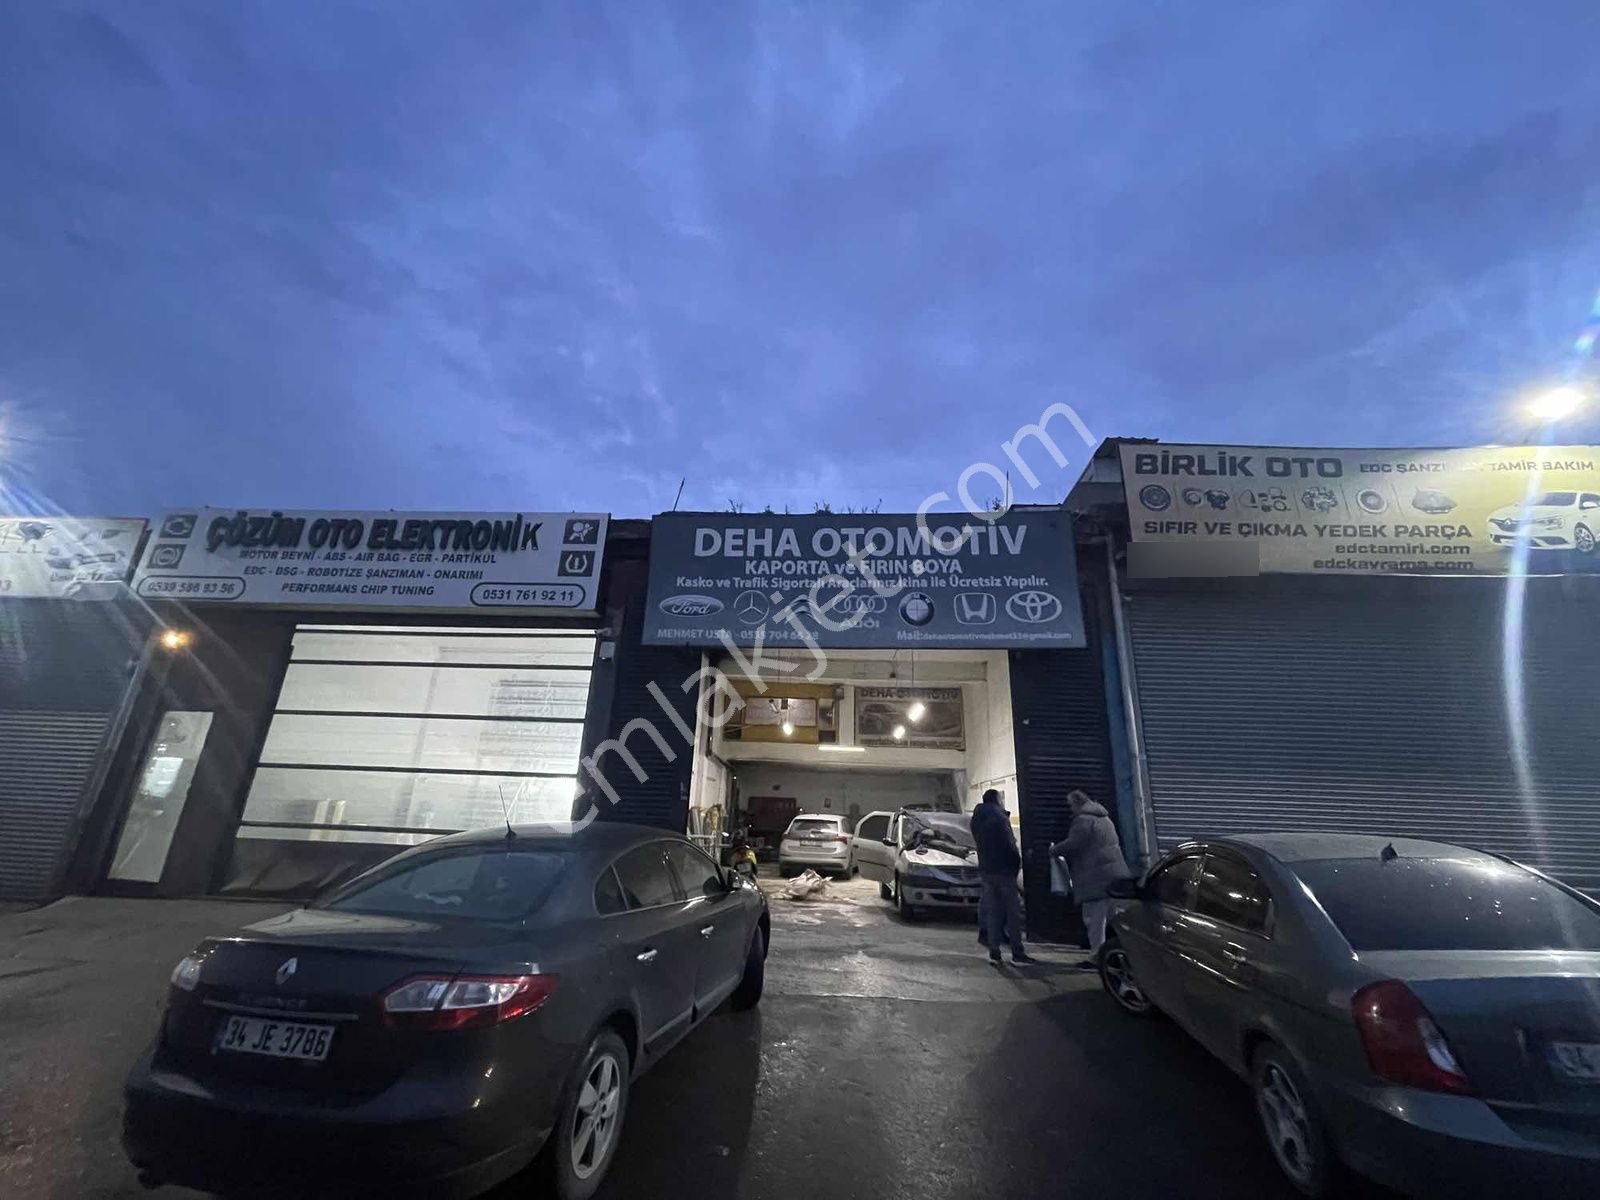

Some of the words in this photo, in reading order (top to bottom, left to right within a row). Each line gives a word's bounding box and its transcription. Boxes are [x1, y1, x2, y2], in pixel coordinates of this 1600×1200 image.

[1135, 450, 1255, 477] BİRLİK
[1265, 456, 1344, 478] OTO
[1490, 460, 1538, 471] TAMİR
[1542, 460, 1594, 471] BAKIM
[206, 511, 307, 553] ÇÖZÜM
[308, 517, 364, 549] OTO
[367, 513, 543, 552] ELEKTRONİK
[1144, 520, 1198, 535] SIFIR
[1204, 522, 1232, 535] VE
[1238, 522, 1307, 538] ÇIKMA
[1314, 524, 1387, 538] YEDEK
[1394, 524, 1473, 540] PARÇA
[694, 527, 802, 557] DEHA
[811, 518, 1028, 557] OTOMOTİV
[1335, 543, 1472, 555] edctamiri.com
[240, 550, 279, 559] MOTOR
[323, 552, 346, 561] ABS
[355, 552, 373, 561] AIR
[377, 553, 399, 562] BAG
[409, 553, 432, 562] EGR
[745, 559, 831, 575] KAPORTA
[835, 562, 856, 575] ve
[860, 559, 908, 574] FIRIN
[911, 559, 963, 574] BOYA
[1312, 558, 1474, 570] edckavrama.com
[243, 566, 266, 575] EDC
[275, 566, 298, 576] DSG
[307, 566, 363, 577] ROBOTİZE
[365, 568, 425, 579] ŞANZIMAN
[433, 570, 483, 580] ONARIMI
[676, 576, 714, 588] Kasko
[716, 579, 731, 588] ve
[732, 576, 768, 588] Trafik
[950, 575, 1002, 588] Ücretsiz
[281, 583, 358, 594] PERFORMANS
[361, 585, 388, 595] CHIP
[391, 585, 435, 595] TUNING
[482, 589, 511, 600] 0531
[516, 589, 537, 600] 761
[541, 590, 557, 600] 92
[560, 590, 574, 601] 11
[671, 600, 711, 615] Ford
[657, 628, 702, 639] MEHMET
[225, 1018, 249, 1047] 34
[252, 1023, 278, 1051] JE
